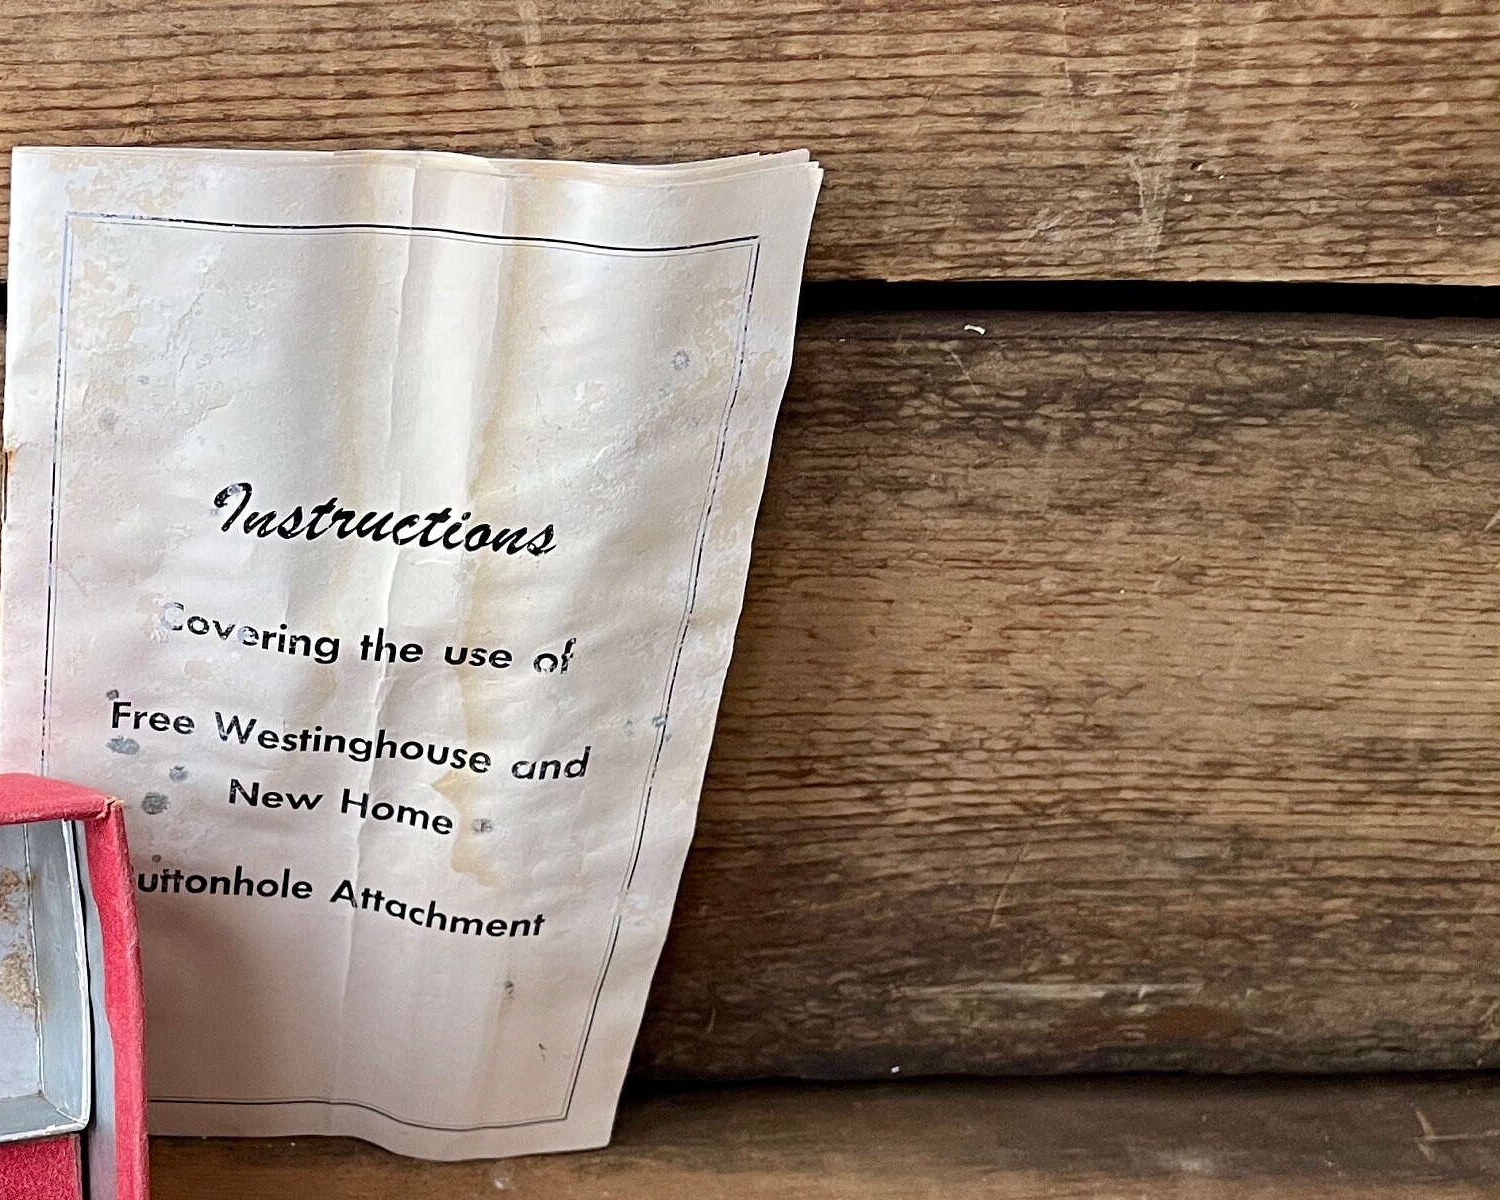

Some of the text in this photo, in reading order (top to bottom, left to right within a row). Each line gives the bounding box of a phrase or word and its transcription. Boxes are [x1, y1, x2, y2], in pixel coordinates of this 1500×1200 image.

[213, 482, 556, 558] Instructions
[164, 601, 577, 674] Covering the use of
[110, 701, 592, 780] Free Westinghouse and
[228, 778, 454, 836] New Home
[137, 865, 546, 938] uttonhole Attachment
